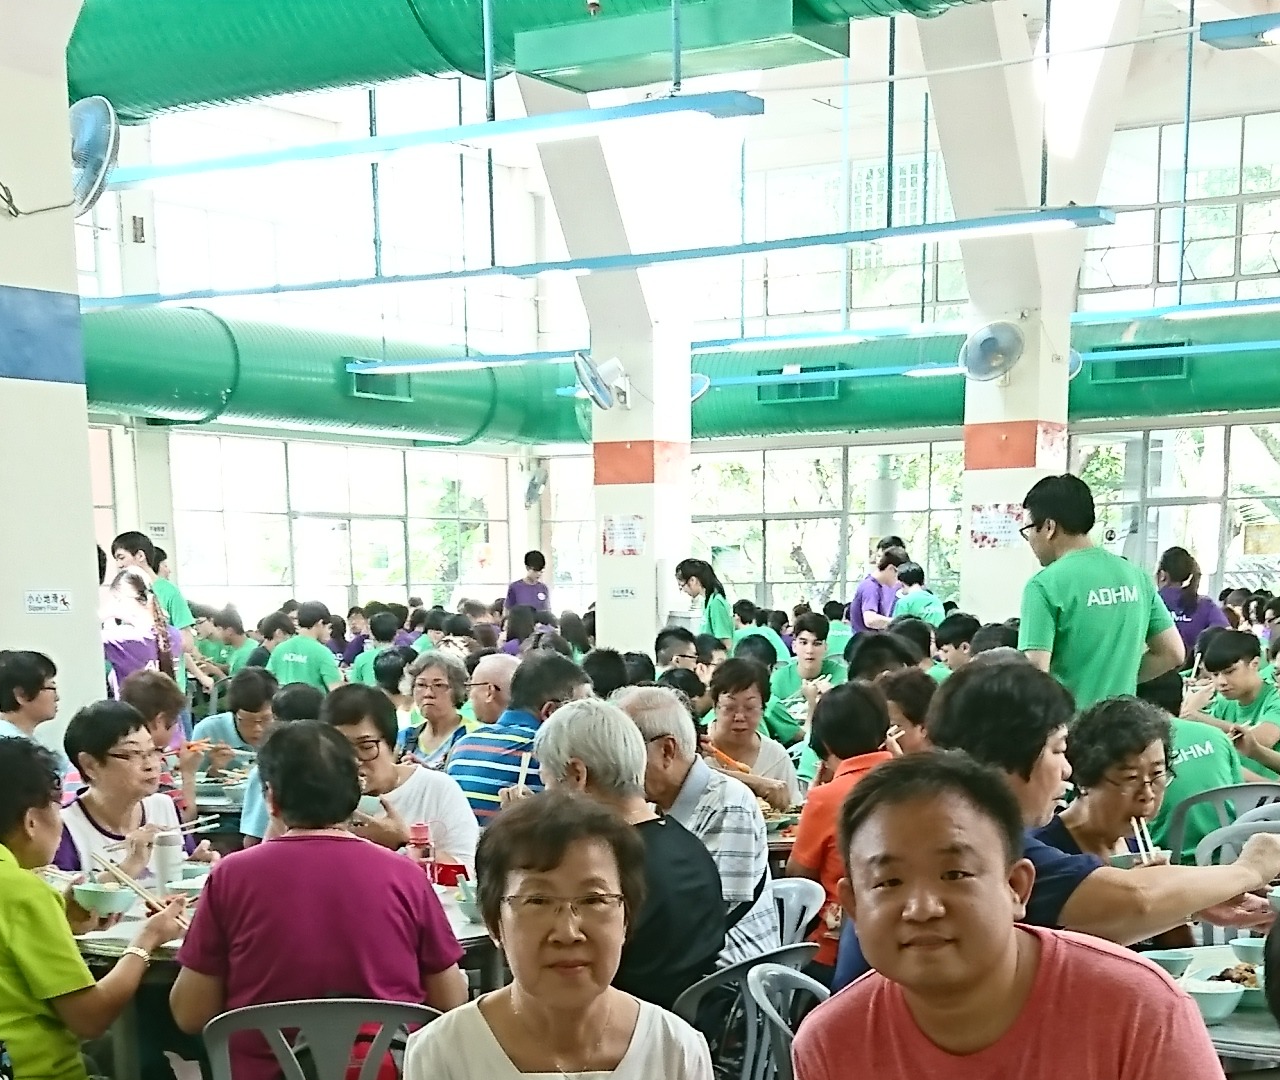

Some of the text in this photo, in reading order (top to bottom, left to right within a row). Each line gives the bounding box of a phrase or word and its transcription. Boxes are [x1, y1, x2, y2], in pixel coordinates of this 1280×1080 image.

[26, 593, 59, 604] 小心地滑
[1087, 584, 1138, 607] ADHM
